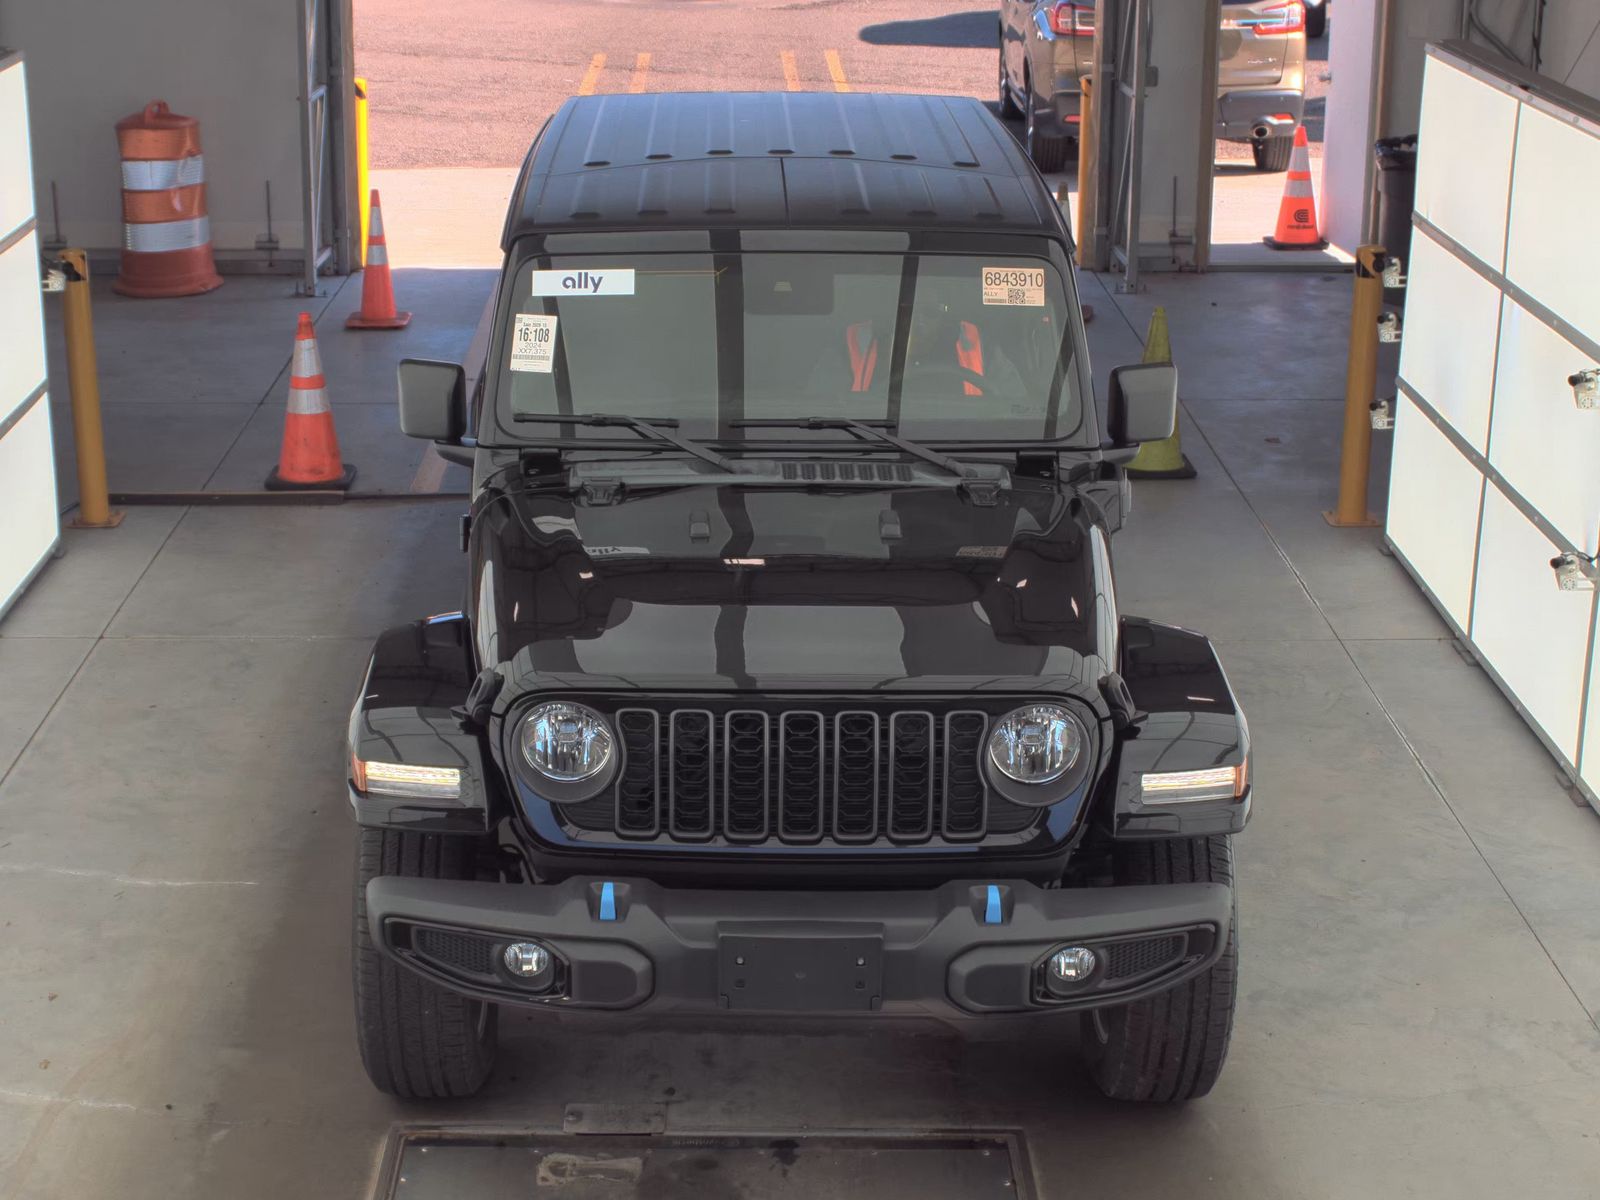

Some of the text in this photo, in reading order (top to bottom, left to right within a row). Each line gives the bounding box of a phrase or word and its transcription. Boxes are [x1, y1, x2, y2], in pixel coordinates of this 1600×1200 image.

[562, 272, 603, 293] ally
[985, 272, 1043, 287] 6843910
[518, 327, 550, 343] 16:108
